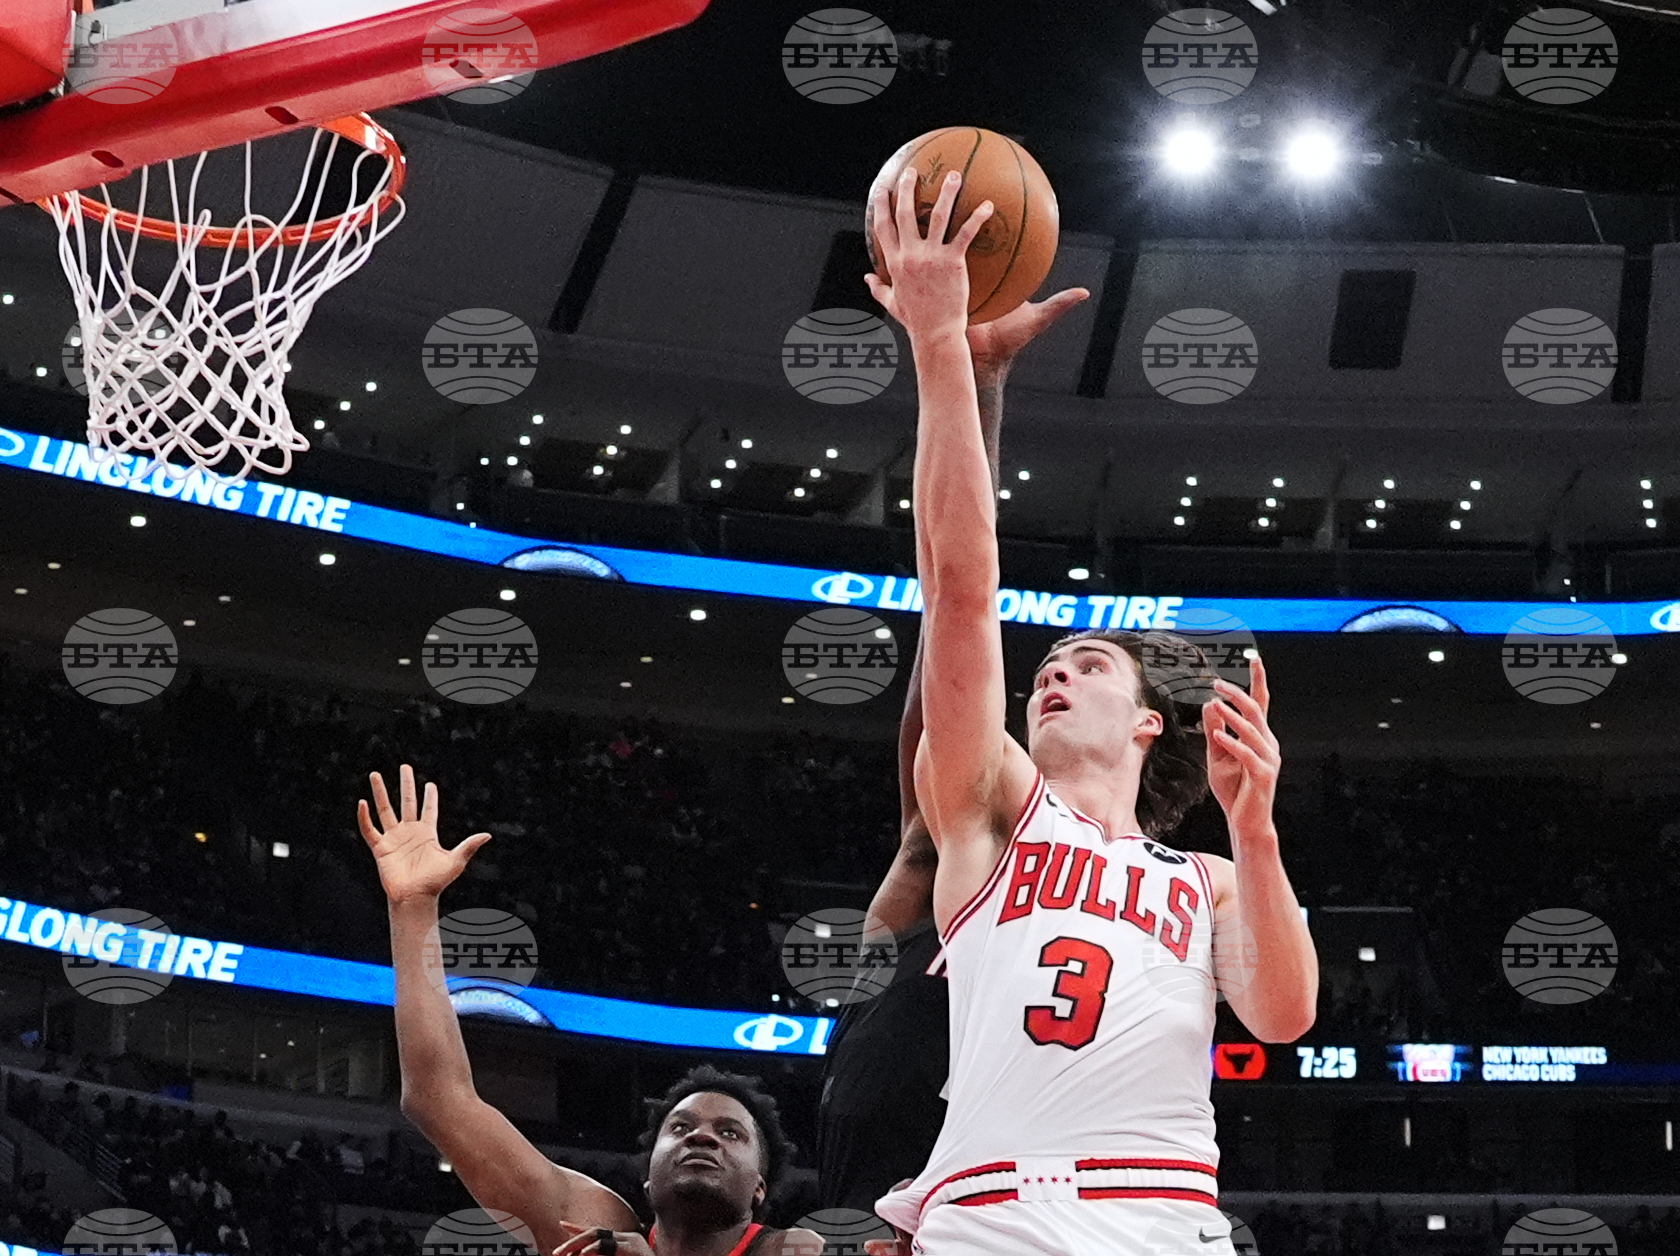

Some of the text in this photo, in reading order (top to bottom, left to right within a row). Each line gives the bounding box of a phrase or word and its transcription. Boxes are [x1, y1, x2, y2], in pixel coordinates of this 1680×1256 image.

[29, 436, 351, 533] LINGLONG TIRE
[877, 576, 1183, 630] LIONG TIRE
[996, 841, 1199, 962] BULLS
[138, 929, 244, 982] TIRE
[1023, 936, 1114, 1051] 3
[1297, 1046, 1357, 1079] 7:25
[1482, 1046, 1512, 1063] NEW
[1513, 1046, 1549, 1063] YORK
[1482, 1063, 1576, 1081] CHICAGO CUBS
